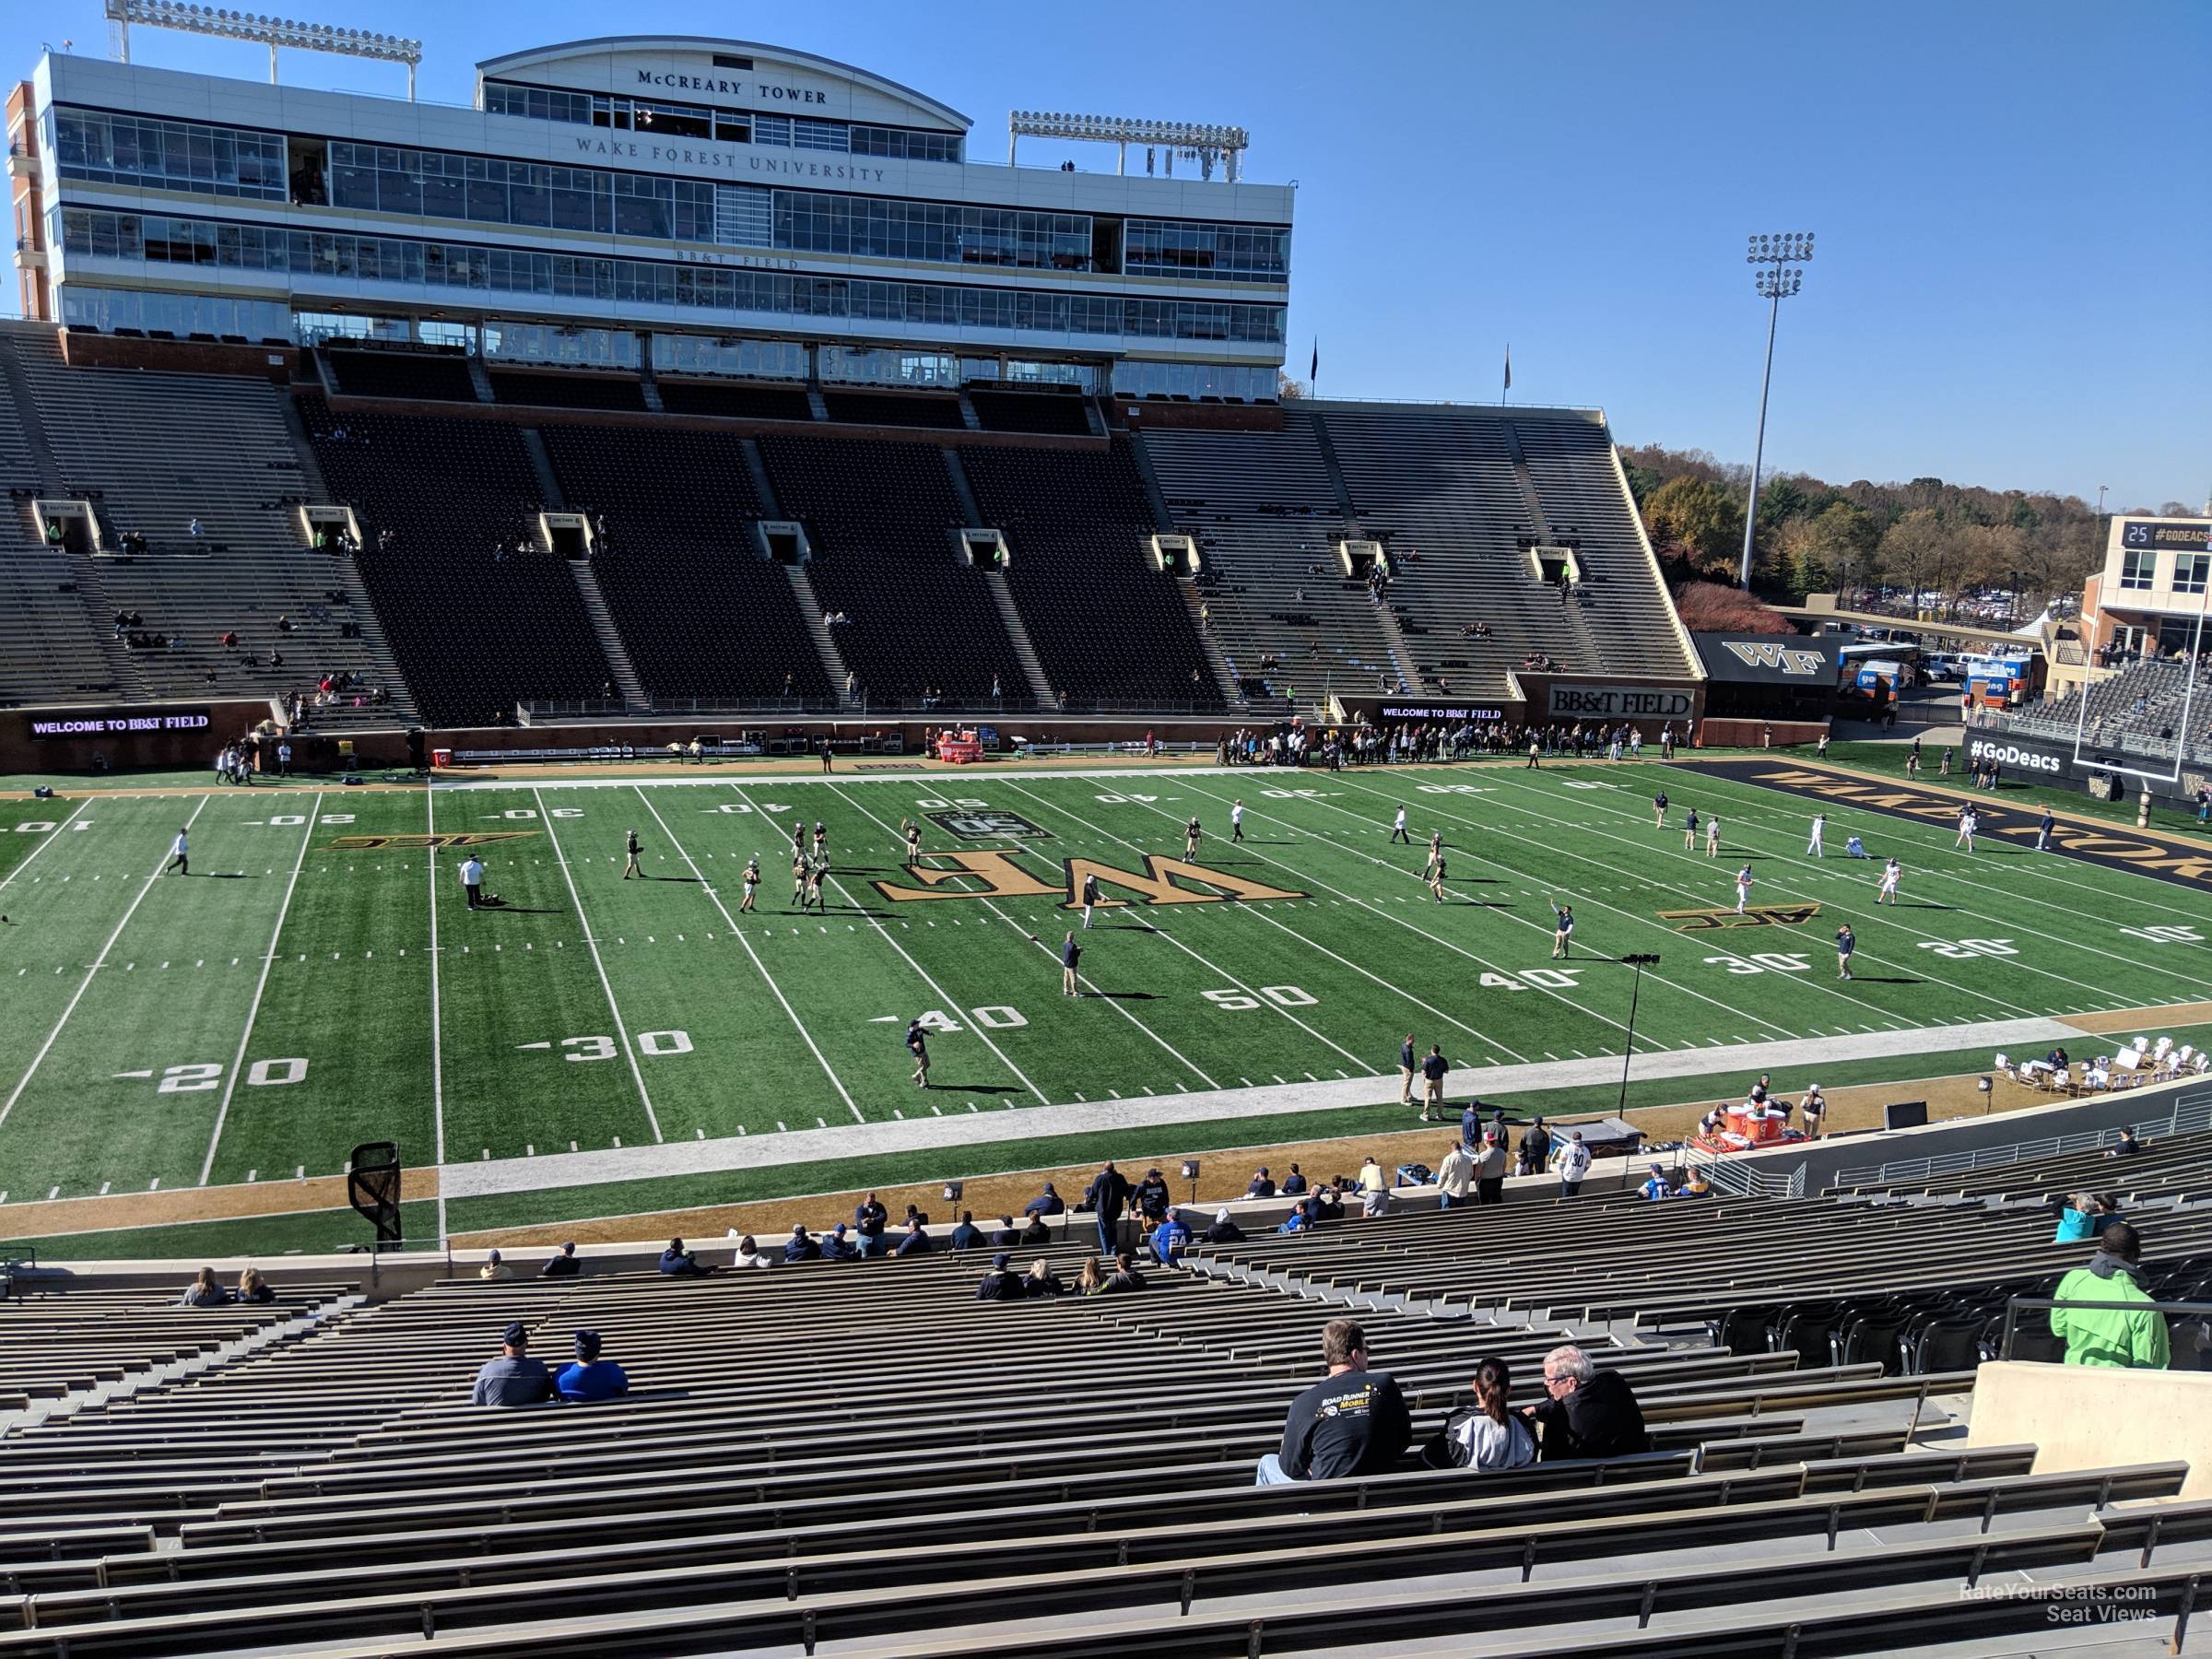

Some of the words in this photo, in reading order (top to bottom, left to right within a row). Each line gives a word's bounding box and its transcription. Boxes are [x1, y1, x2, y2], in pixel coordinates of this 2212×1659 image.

[638, 70, 741, 94] McCREARY
[759, 85, 826, 104] TOWER
[576, 138, 638, 157] WAKE
[653, 147, 736, 167] FOREST
[750, 157, 885, 182] UNIVERSITY
[677, 250, 725, 263] BB&T
[744, 256, 798, 269] FIELD
[2128, 526, 2148, 542] 25
[2154, 528, 2209, 542] #GODEACS
[1722, 641, 1827, 675] WF
[1553, 689, 1618, 712] BB&T
[1622, 692, 1691, 715] FIELD
[1383, 708, 1430, 717] WELCOME
[1431, 709, 1444, 717] TO
[1445, 709, 1468, 718] BB&T
[1471, 710, 1501, 719] FIELD
[33, 721, 105, 734] WELCOME
[107, 720, 126, 731] TO
[128, 717, 162, 730] BB&T
[165, 715, 208, 728] FIELD
[1971, 740, 2061, 771] #GoDeacs
[1750, 771, 2008, 819] WAKE
[1571, 1153, 1584, 1168] 30
[1169, 1235, 1187, 1245] 24
[1322, 1396, 1342, 1407] ROAD
[1343, 1391, 1371, 1401] RUNNER
[1339, 1398, 1371, 1408] MOBILE
